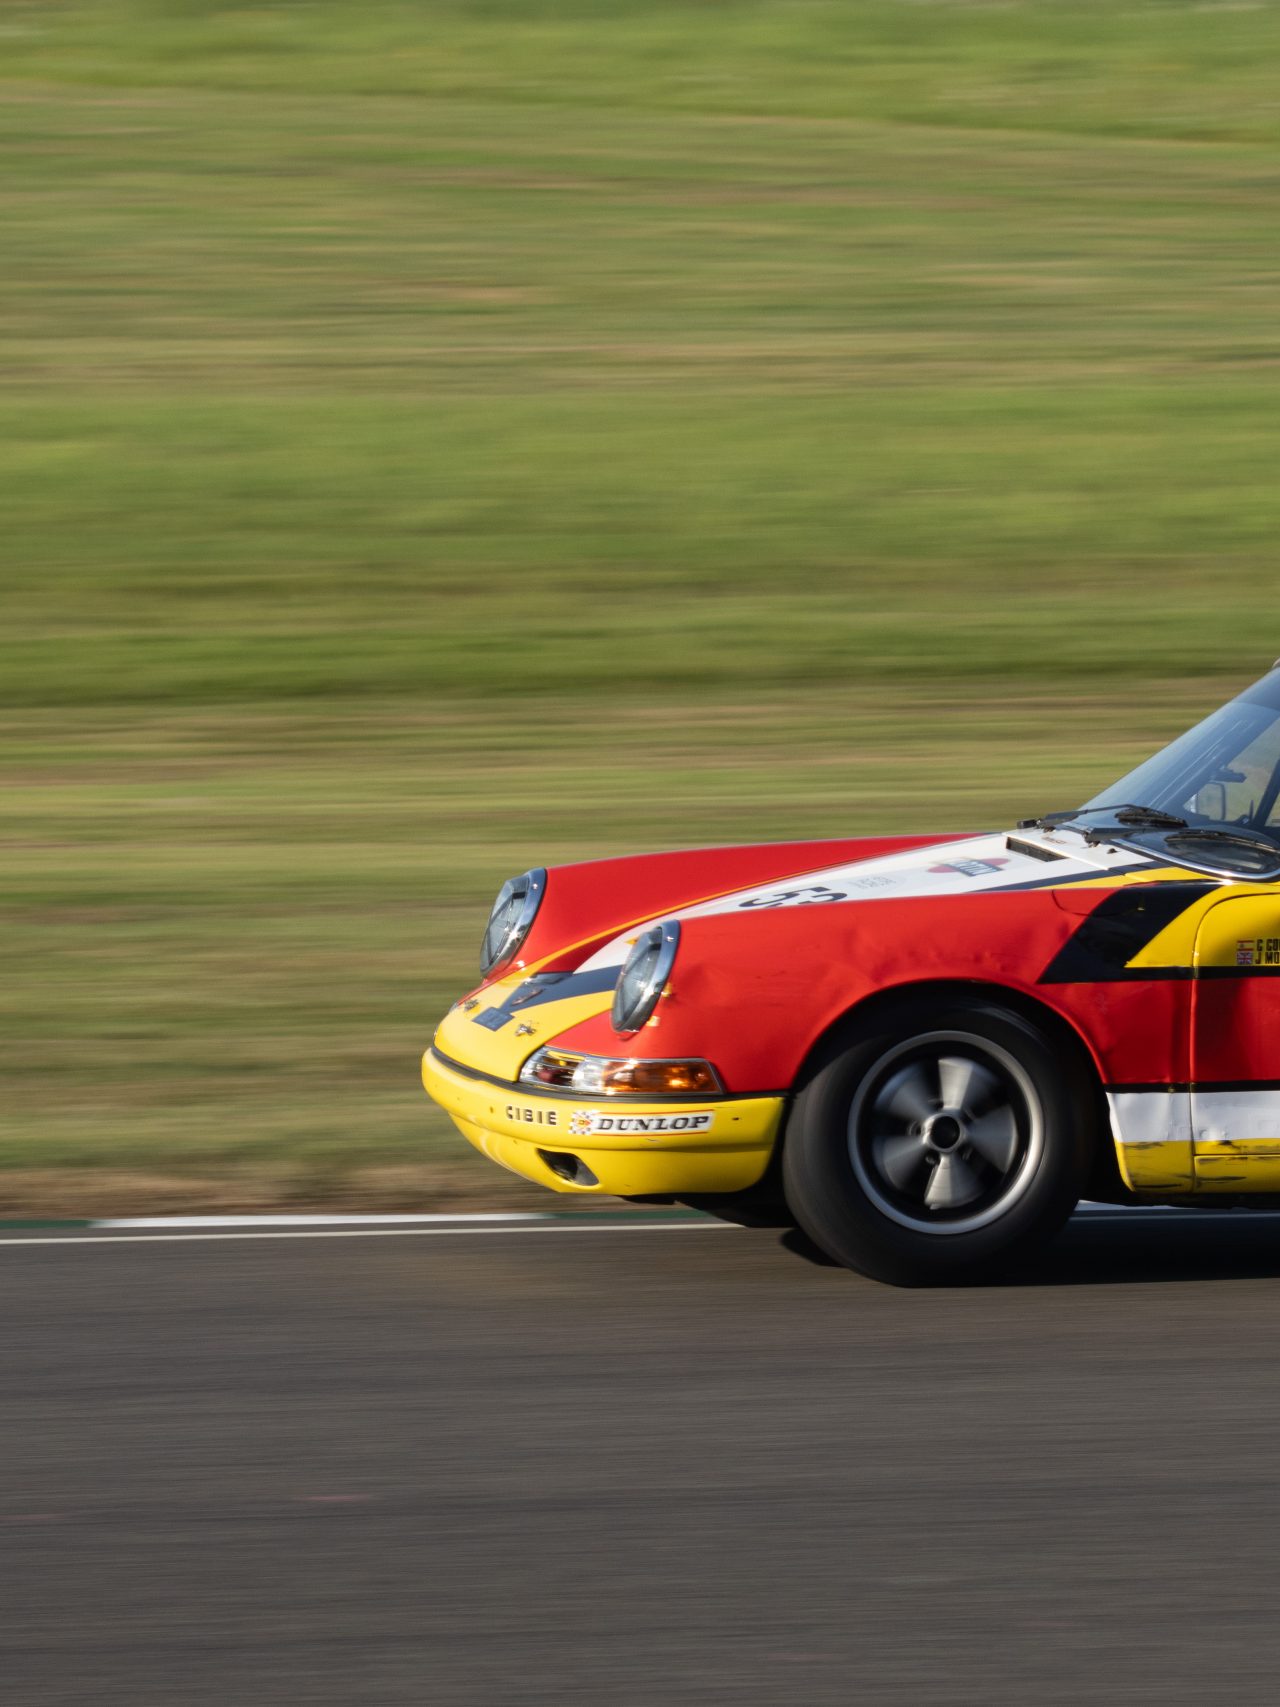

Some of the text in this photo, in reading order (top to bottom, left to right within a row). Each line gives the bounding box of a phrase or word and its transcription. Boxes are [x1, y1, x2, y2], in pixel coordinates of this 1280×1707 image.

[1256, 952, 1262, 964] J
[505, 1105, 557, 1126] CIBIE
[597, 1115, 710, 1131] DUNLOP
